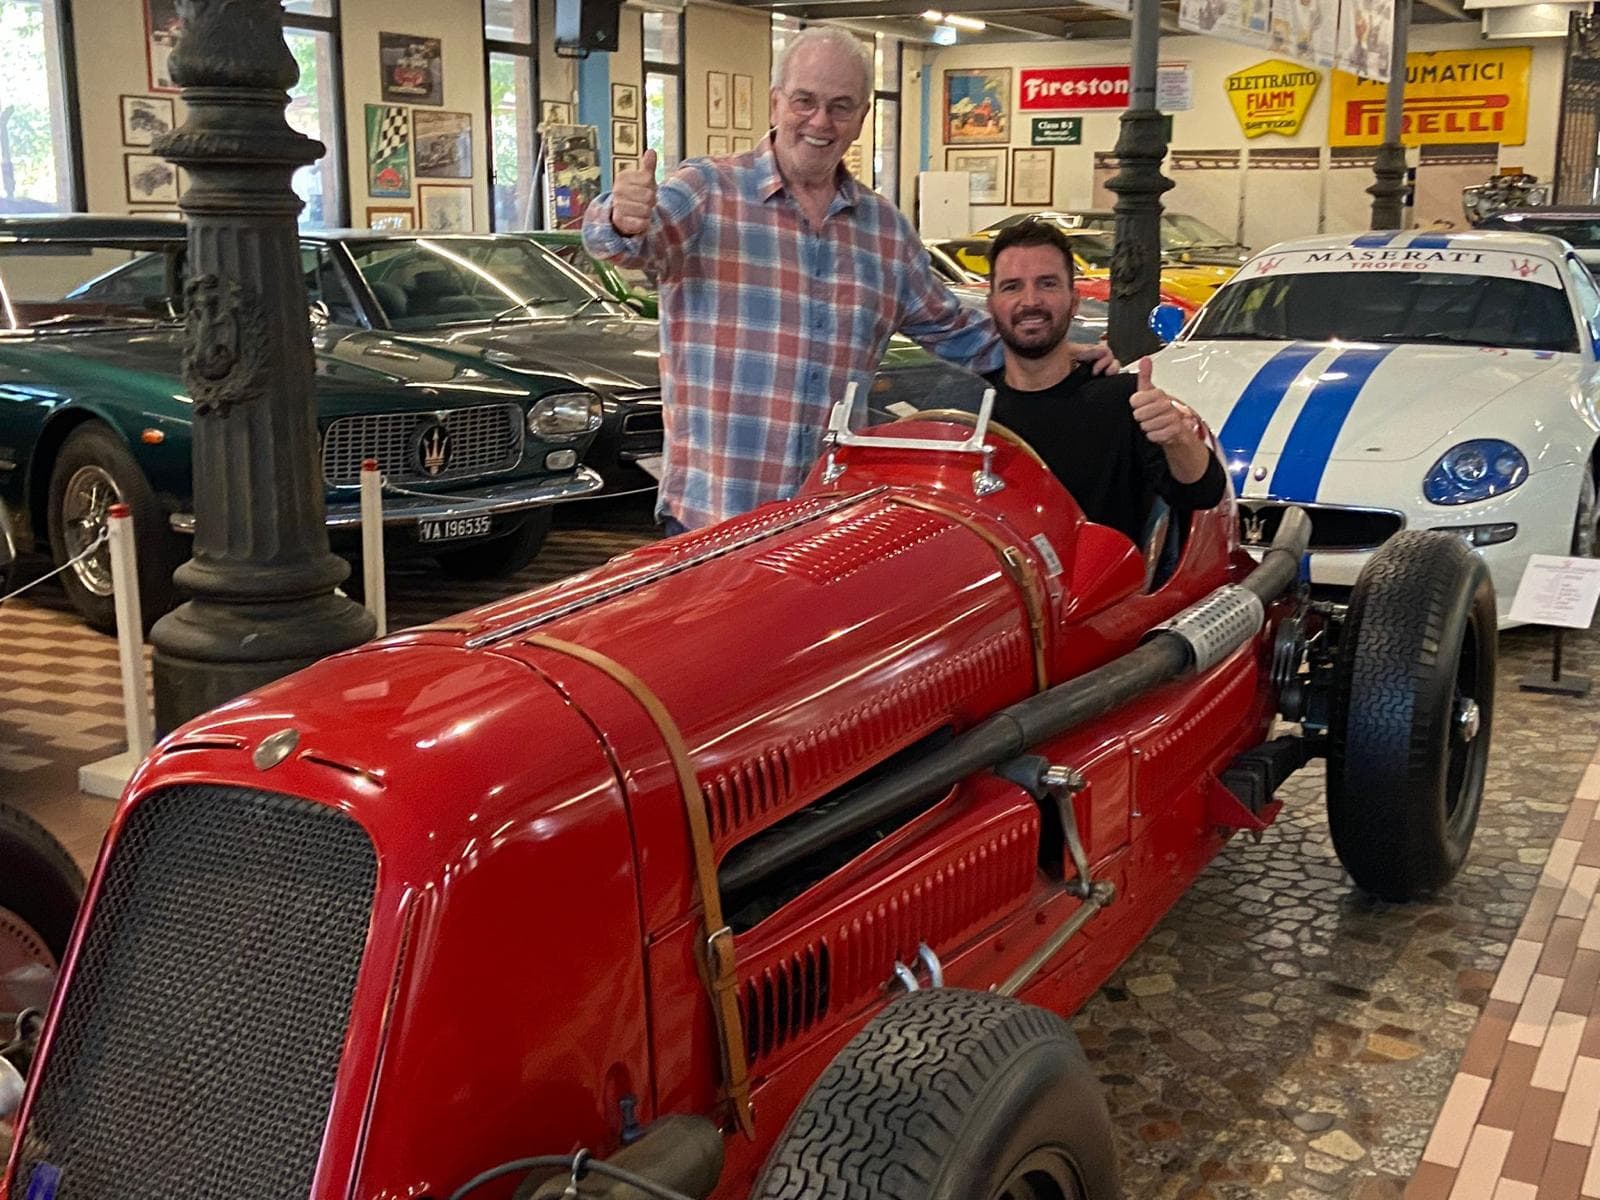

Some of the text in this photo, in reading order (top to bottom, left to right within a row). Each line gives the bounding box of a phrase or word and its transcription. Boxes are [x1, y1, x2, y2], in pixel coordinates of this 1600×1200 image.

[1023, 77, 1129, 102] Fireston
[1229, 71, 1317, 91] ELETTRAUTO
[1247, 91, 1294, 110] FIAMM
[1345, 95, 1509, 135] PIRELLI
[1306, 251, 1486, 264] MASERATI
[1351, 262, 1429, 270] TROFEO
[444, 516, 491, 538] 196535
